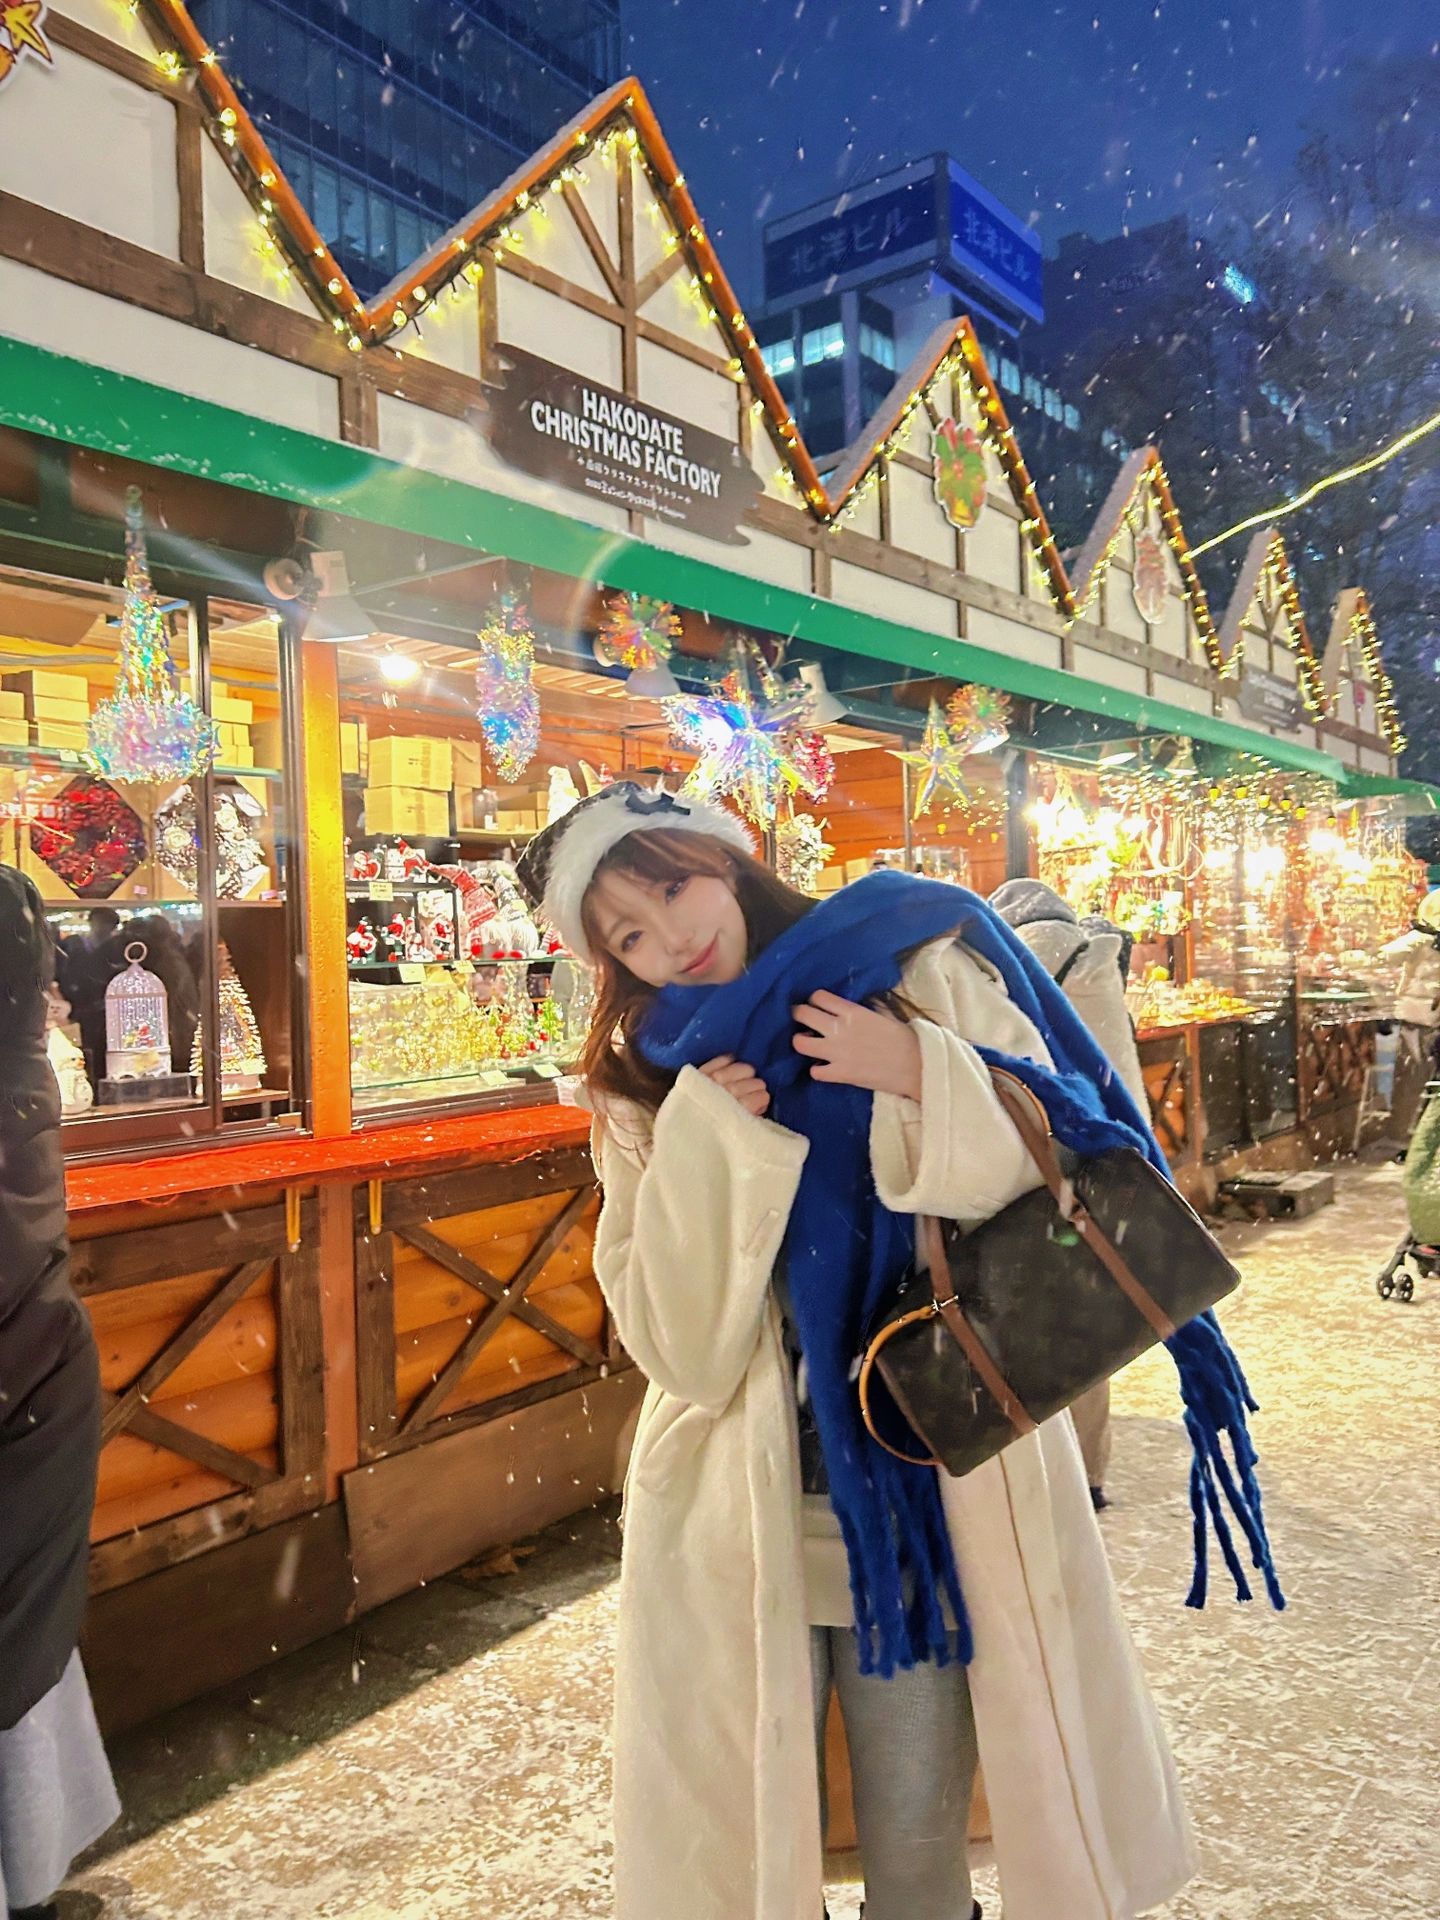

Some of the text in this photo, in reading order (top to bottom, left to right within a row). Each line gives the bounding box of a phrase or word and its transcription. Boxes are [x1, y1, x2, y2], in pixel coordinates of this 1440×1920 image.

[531, 401, 641, 469] CHRISTMAS
[644, 446, 722, 499] FACTORY
[582, 388, 684, 456] HAKODATE
